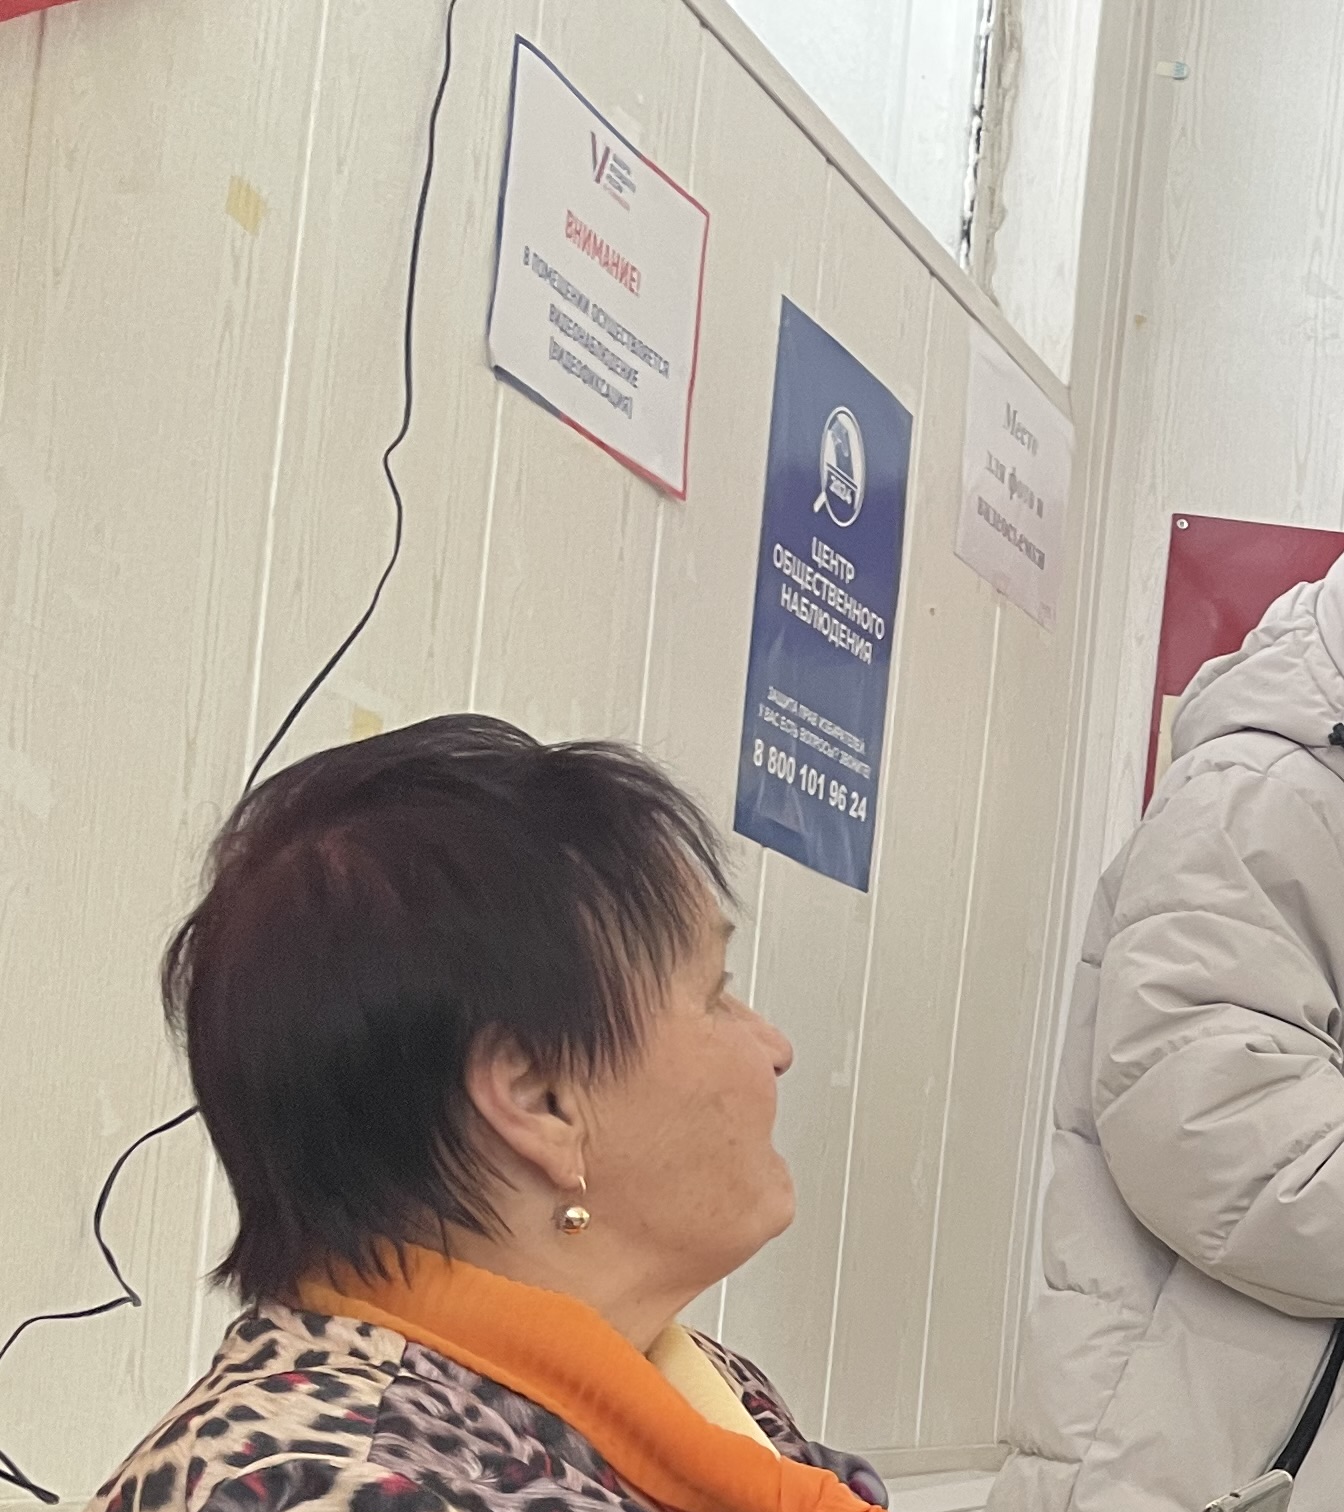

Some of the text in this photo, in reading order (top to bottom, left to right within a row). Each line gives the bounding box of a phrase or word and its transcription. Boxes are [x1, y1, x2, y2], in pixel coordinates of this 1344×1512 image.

[565, 209, 642, 298] ВНИМАНИЕ!
[772, 542, 885, 640] ОБЩЕСТВЕННОГО
[811, 536, 855, 584] ЦЕНТР
[780, 583, 873, 664] НАБЛЮДЕНИЯ
[753, 738, 867, 823] 8 800 101 96 24
